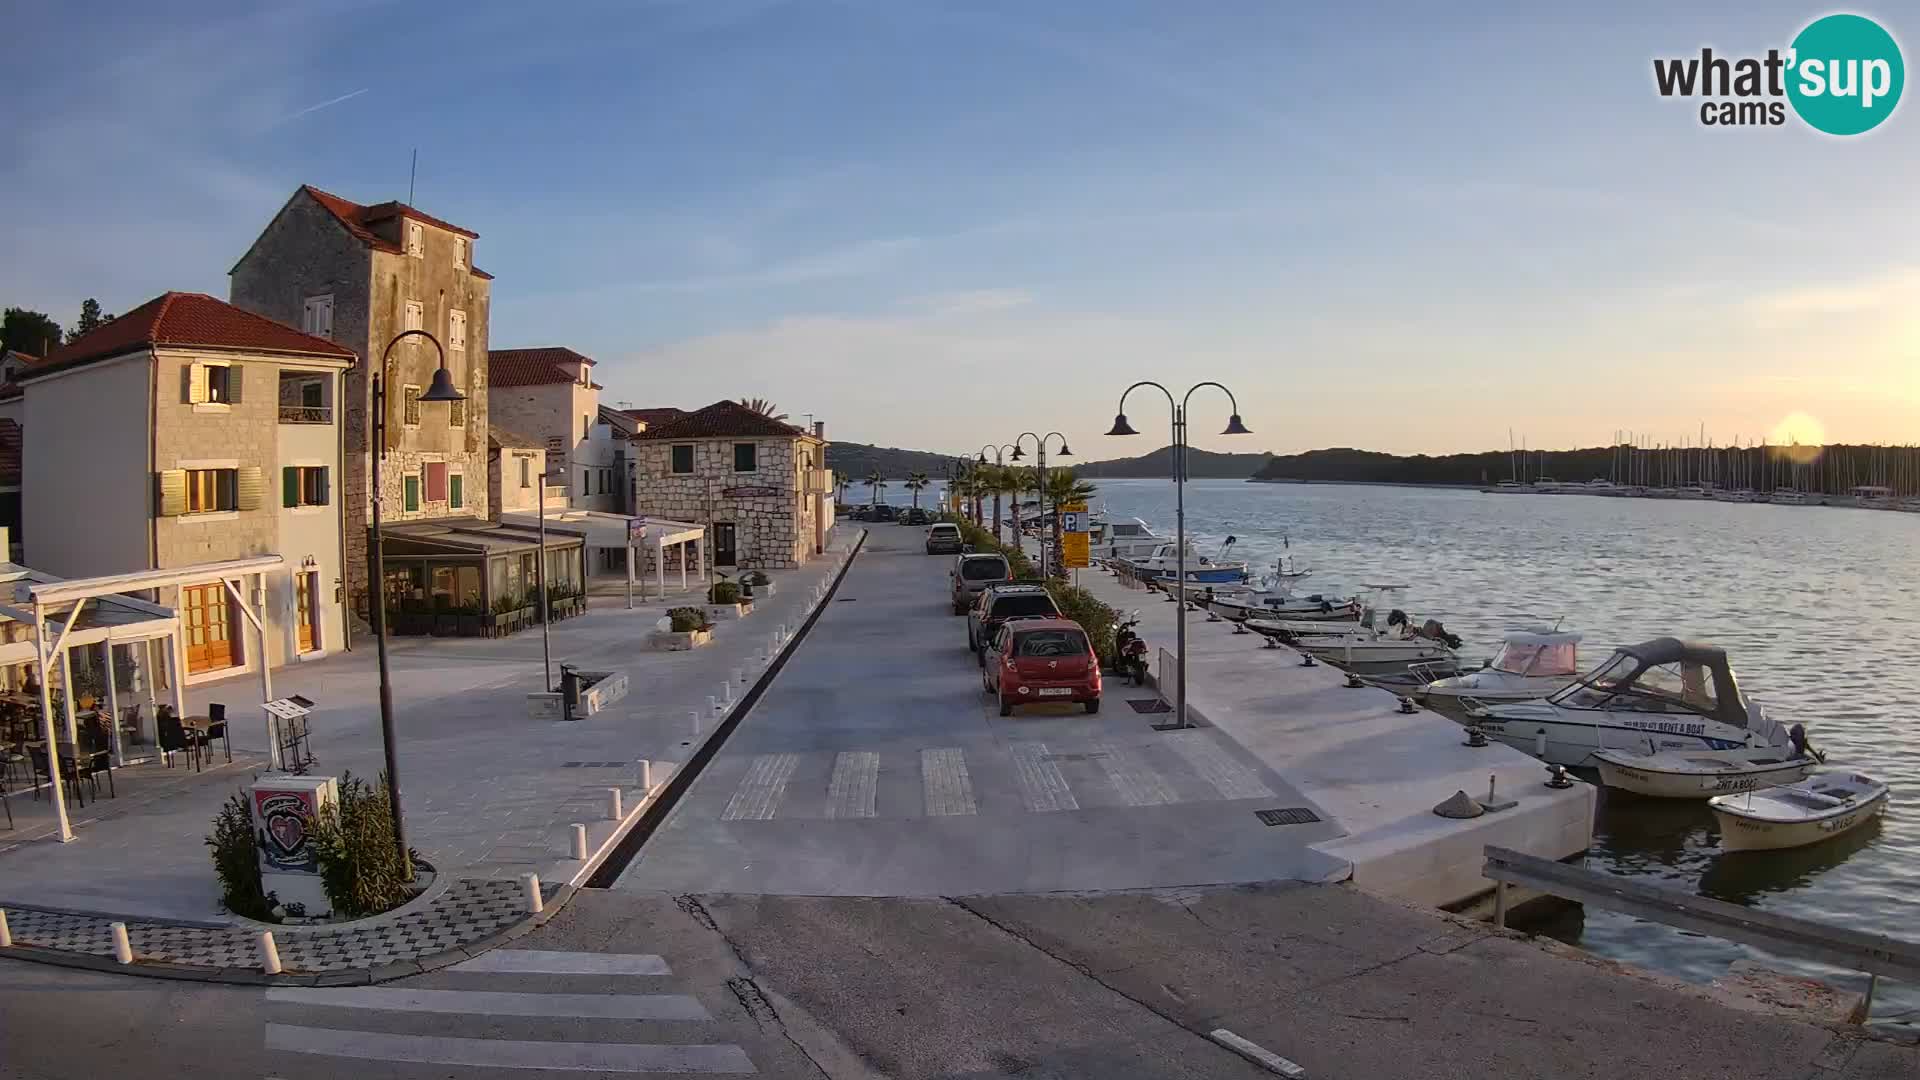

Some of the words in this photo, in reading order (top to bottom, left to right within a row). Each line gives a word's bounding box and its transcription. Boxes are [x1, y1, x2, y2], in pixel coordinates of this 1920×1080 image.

[1065, 514, 1076, 531] P
[1658, 722, 1678, 733] RENT
[1680, 723, 1685, 732] A
[1686, 723, 1705, 735] BOAT
